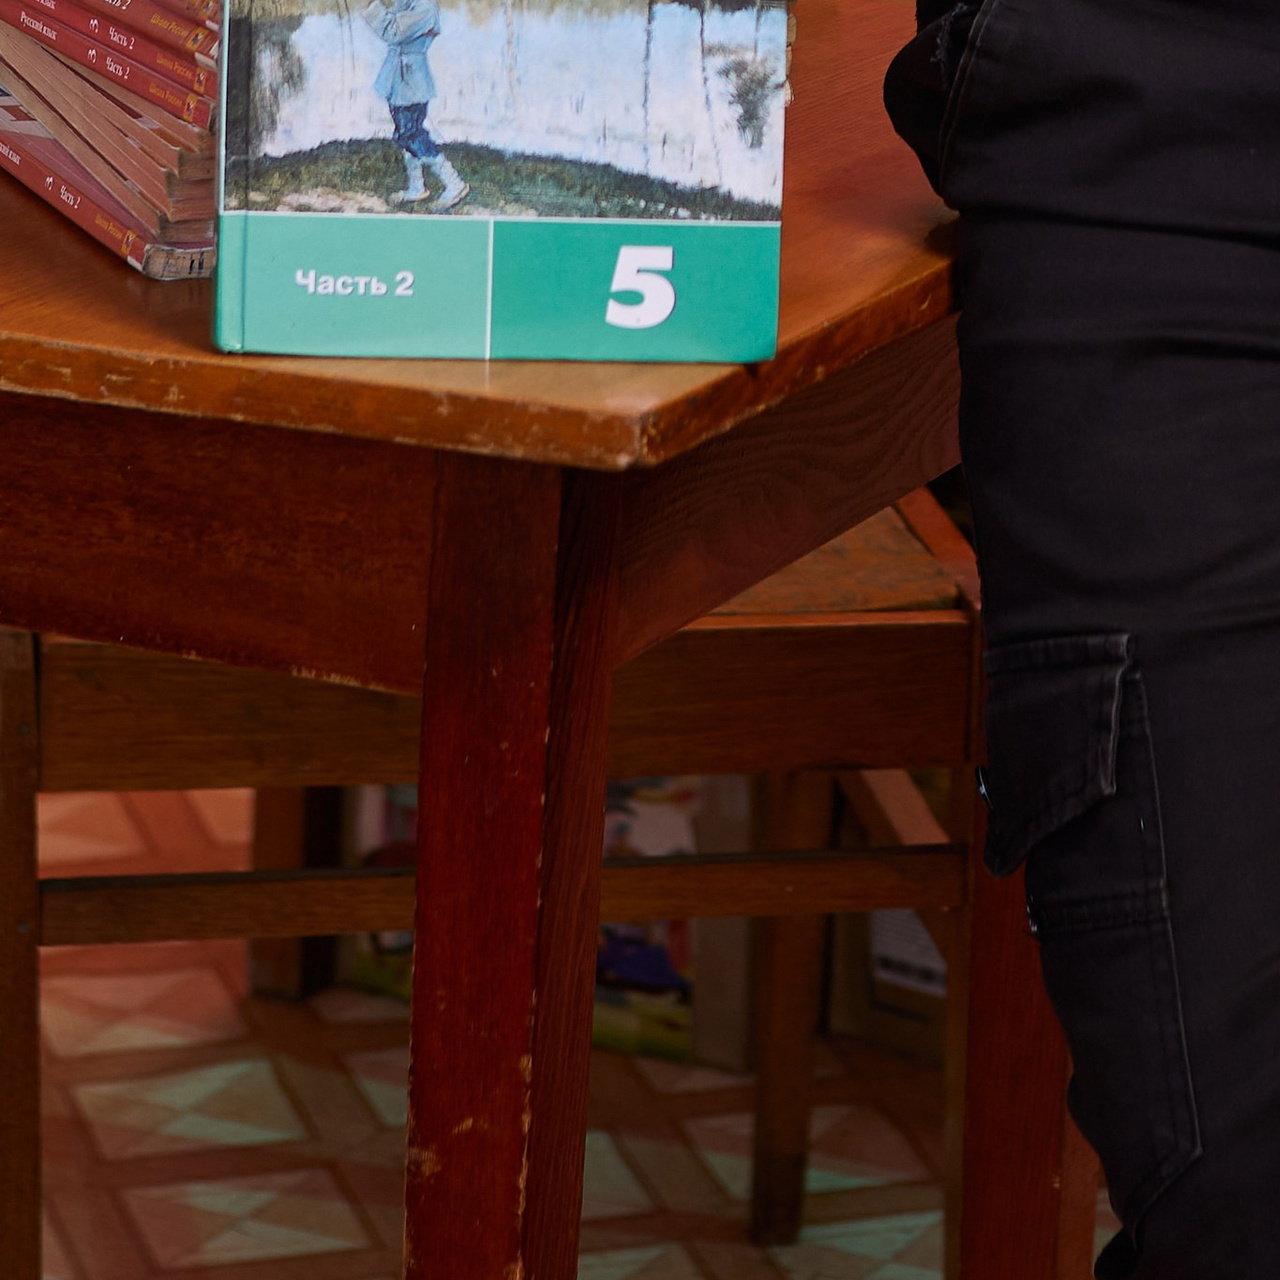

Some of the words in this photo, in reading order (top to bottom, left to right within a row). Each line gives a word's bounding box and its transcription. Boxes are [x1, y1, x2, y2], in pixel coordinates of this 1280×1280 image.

[19, 10, 44, 34] Русский
[105, 56, 125, 77] Часть
[124, 66, 131, 80] 2
[108, 26, 128, 46] Часть
[128, 37, 136, 51] 2
[60, 185, 75, 207] Часть
[74, 196, 82, 210] 2
[294, 268, 388, 298] Часть
[393, 269, 416, 298] 2
[603, 243, 678, 330] 5
